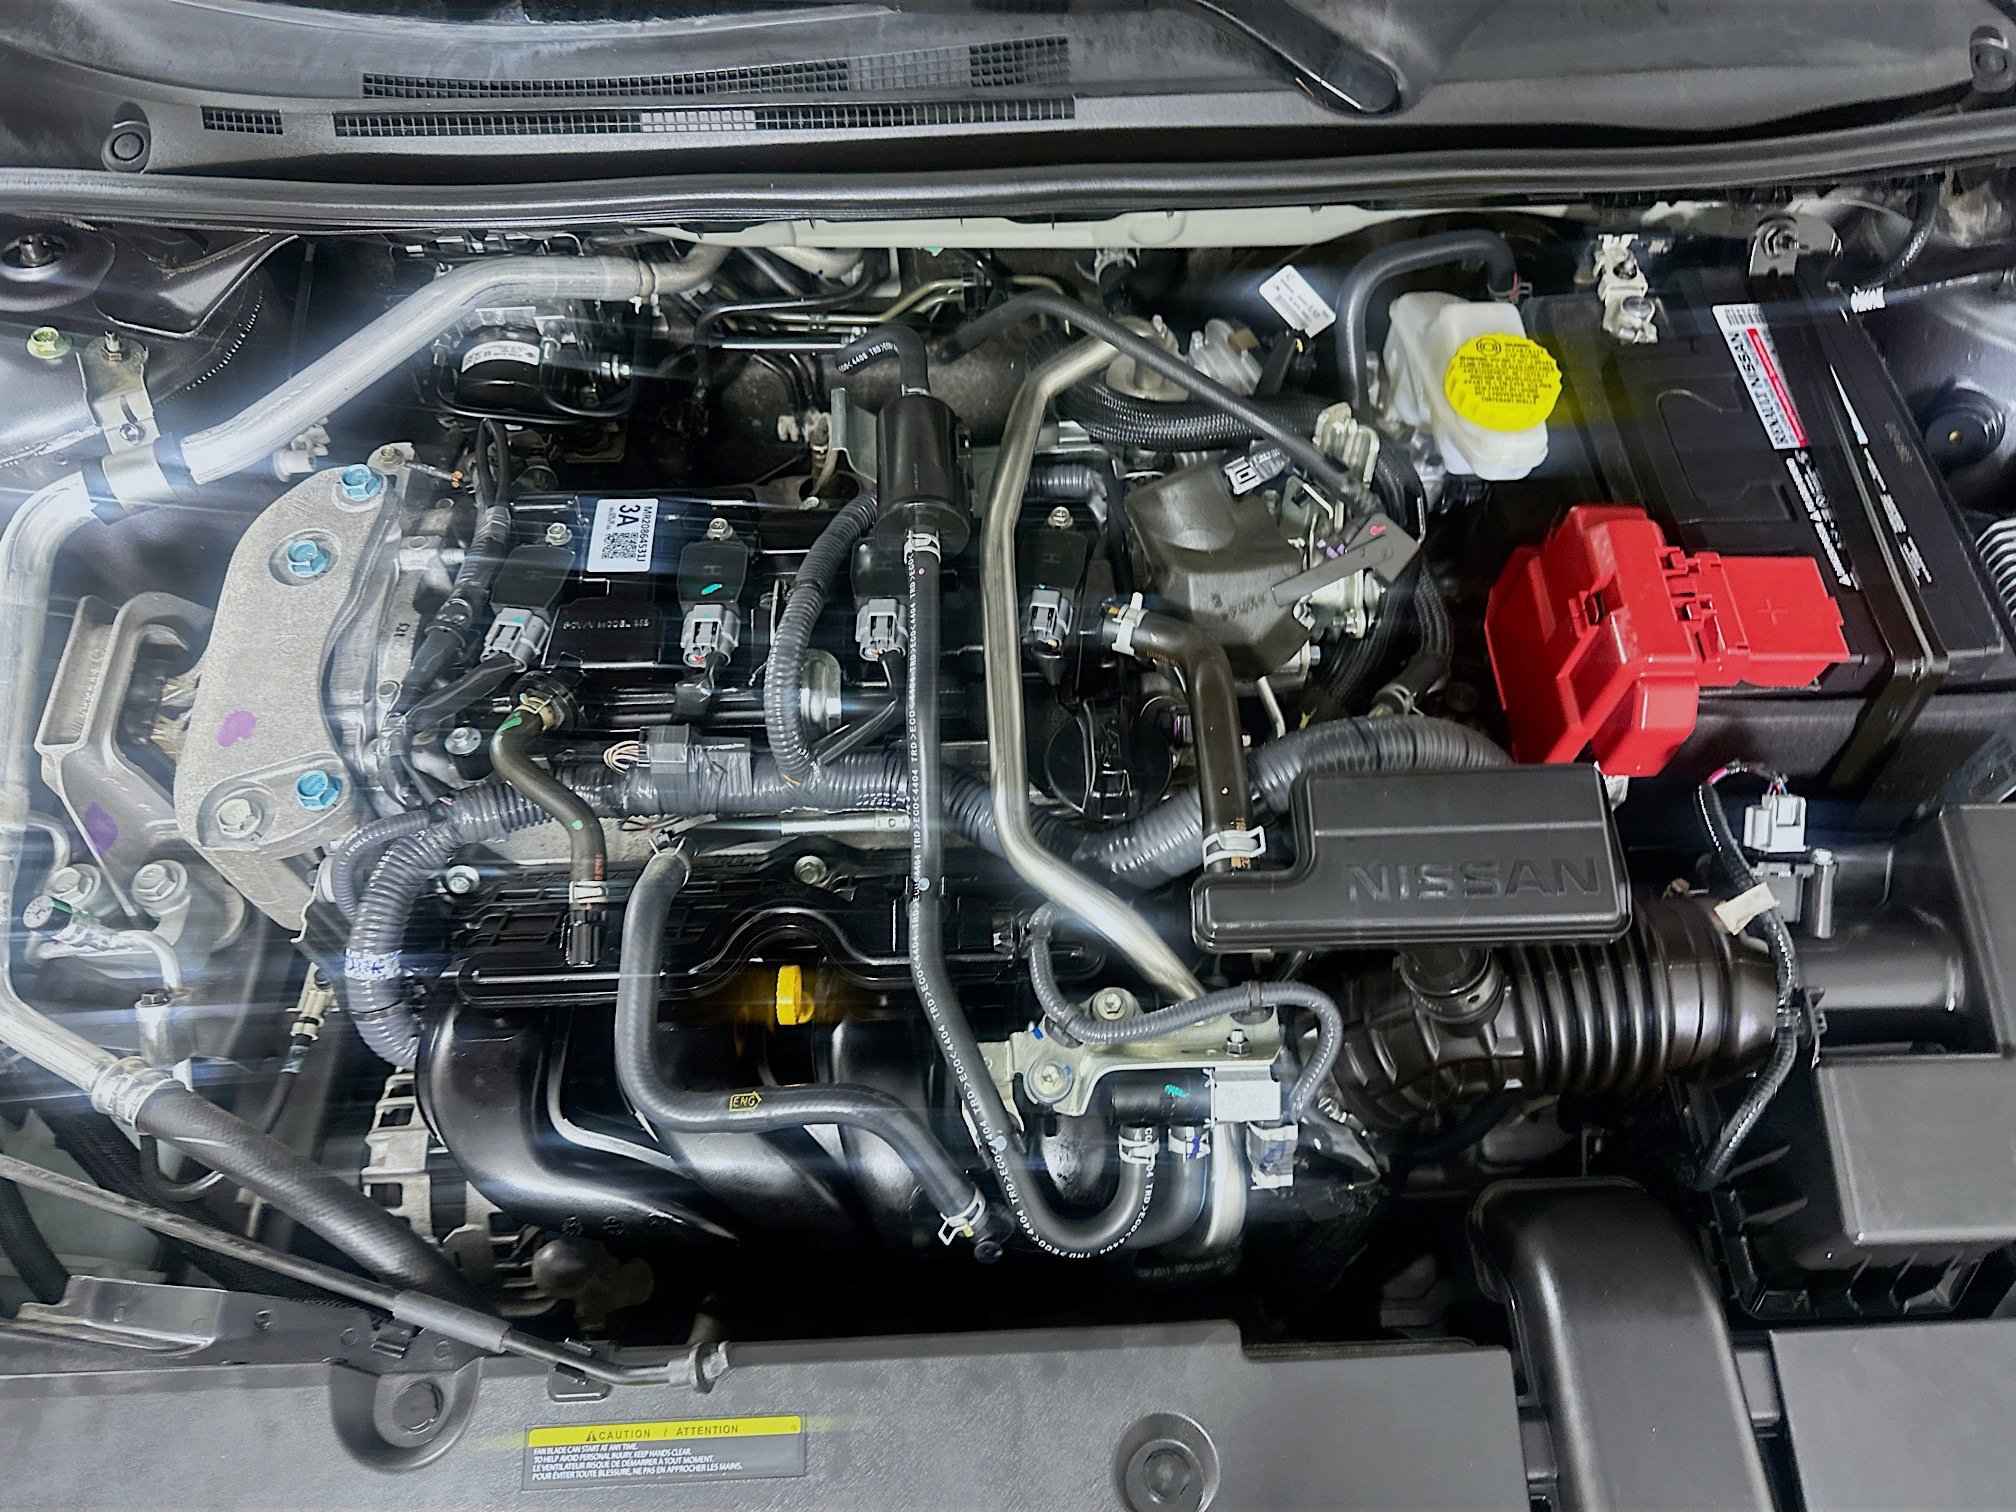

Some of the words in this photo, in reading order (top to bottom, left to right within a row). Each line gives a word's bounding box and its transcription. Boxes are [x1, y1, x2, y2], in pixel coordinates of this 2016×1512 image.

[616, 504, 641, 527] 3A
[1347, 856, 1601, 901] NISSAN
[733, 1096, 756, 1108] ENG
[599, 1428, 651, 1441] CAUTION
[676, 1425, 739, 1437] ATTENTION
[533, 1456, 543, 1464] TO
[544, 1455, 559, 1463] HELP
[559, 1454, 579, 1462] AVOID
[580, 1452, 611, 1461] PERSONAL
[649, 1449, 670, 1457] HANDS
[547, 1447, 566, 1455] BLADE
[567, 1446, 580, 1454] CAN
[582, 1445, 600, 1453] START
[600, 1444, 608, 1452] AT
[586, 1461, 610, 1469] RISQUE
[664, 1456, 682, 1465] TOUT
[532, 1472, 551, 1480] POUR
[576, 1470, 597, 1478] TOUTE
[666, 1464, 706, 1473] APPROCHER
[707, 1463, 718, 1471] LES
